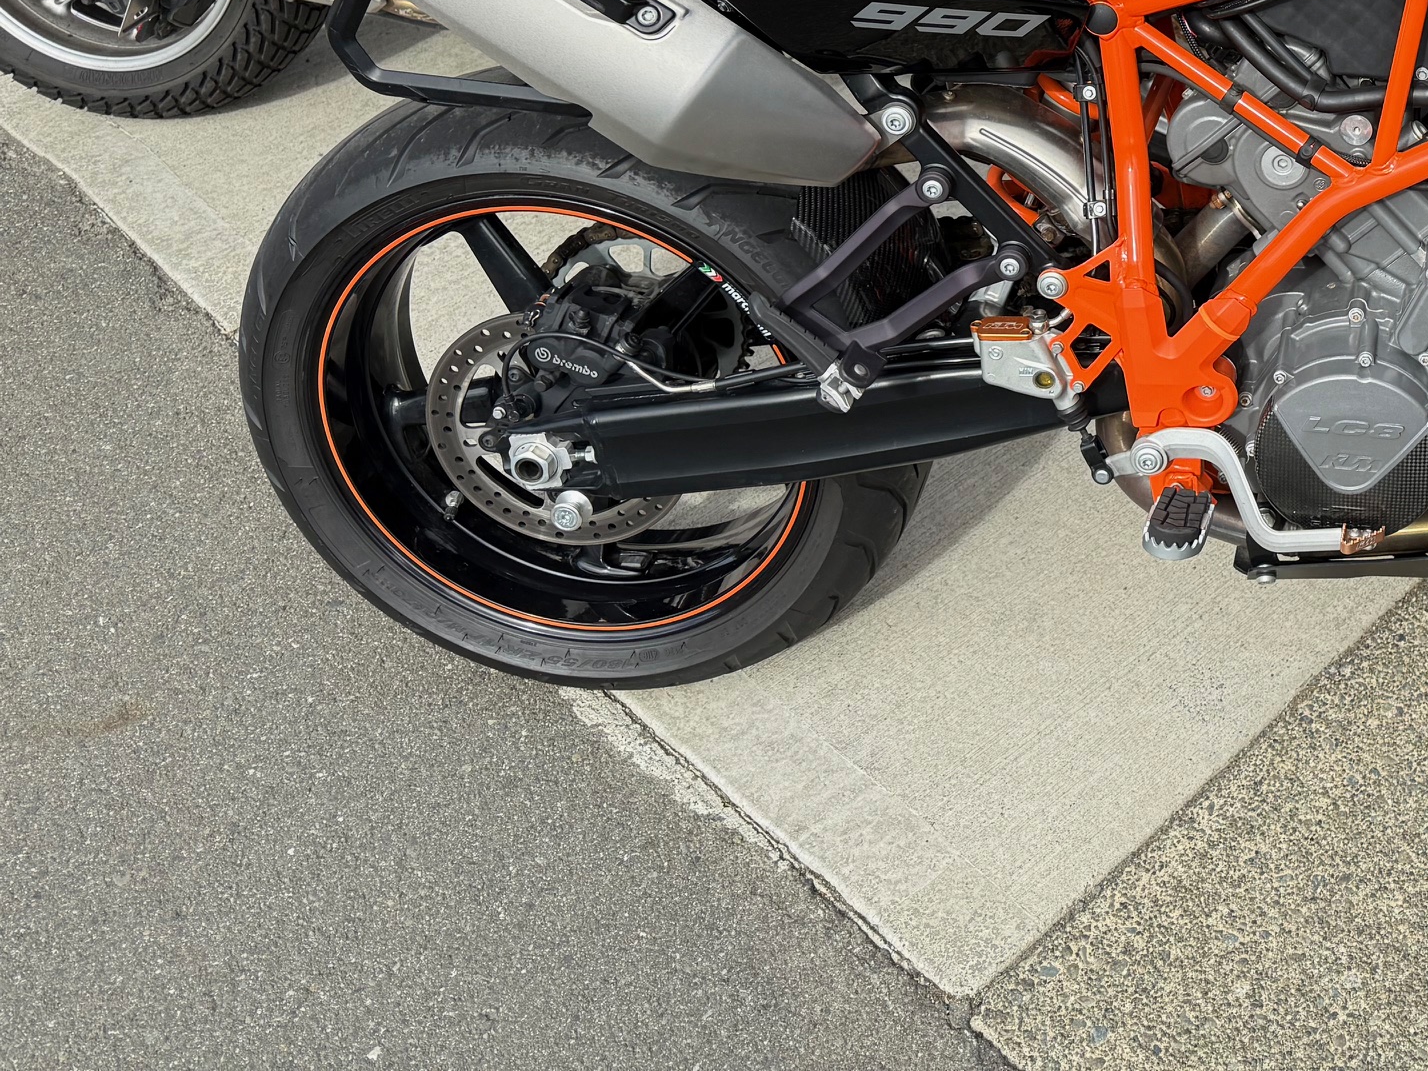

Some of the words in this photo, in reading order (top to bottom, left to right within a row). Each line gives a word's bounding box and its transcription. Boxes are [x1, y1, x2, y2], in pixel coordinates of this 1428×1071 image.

[850, 1, 1052, 38] 990
[552, 354, 599, 378] brembo
[1301, 415, 1405, 440] LC8
[1318, 453, 1382, 473] KTM
